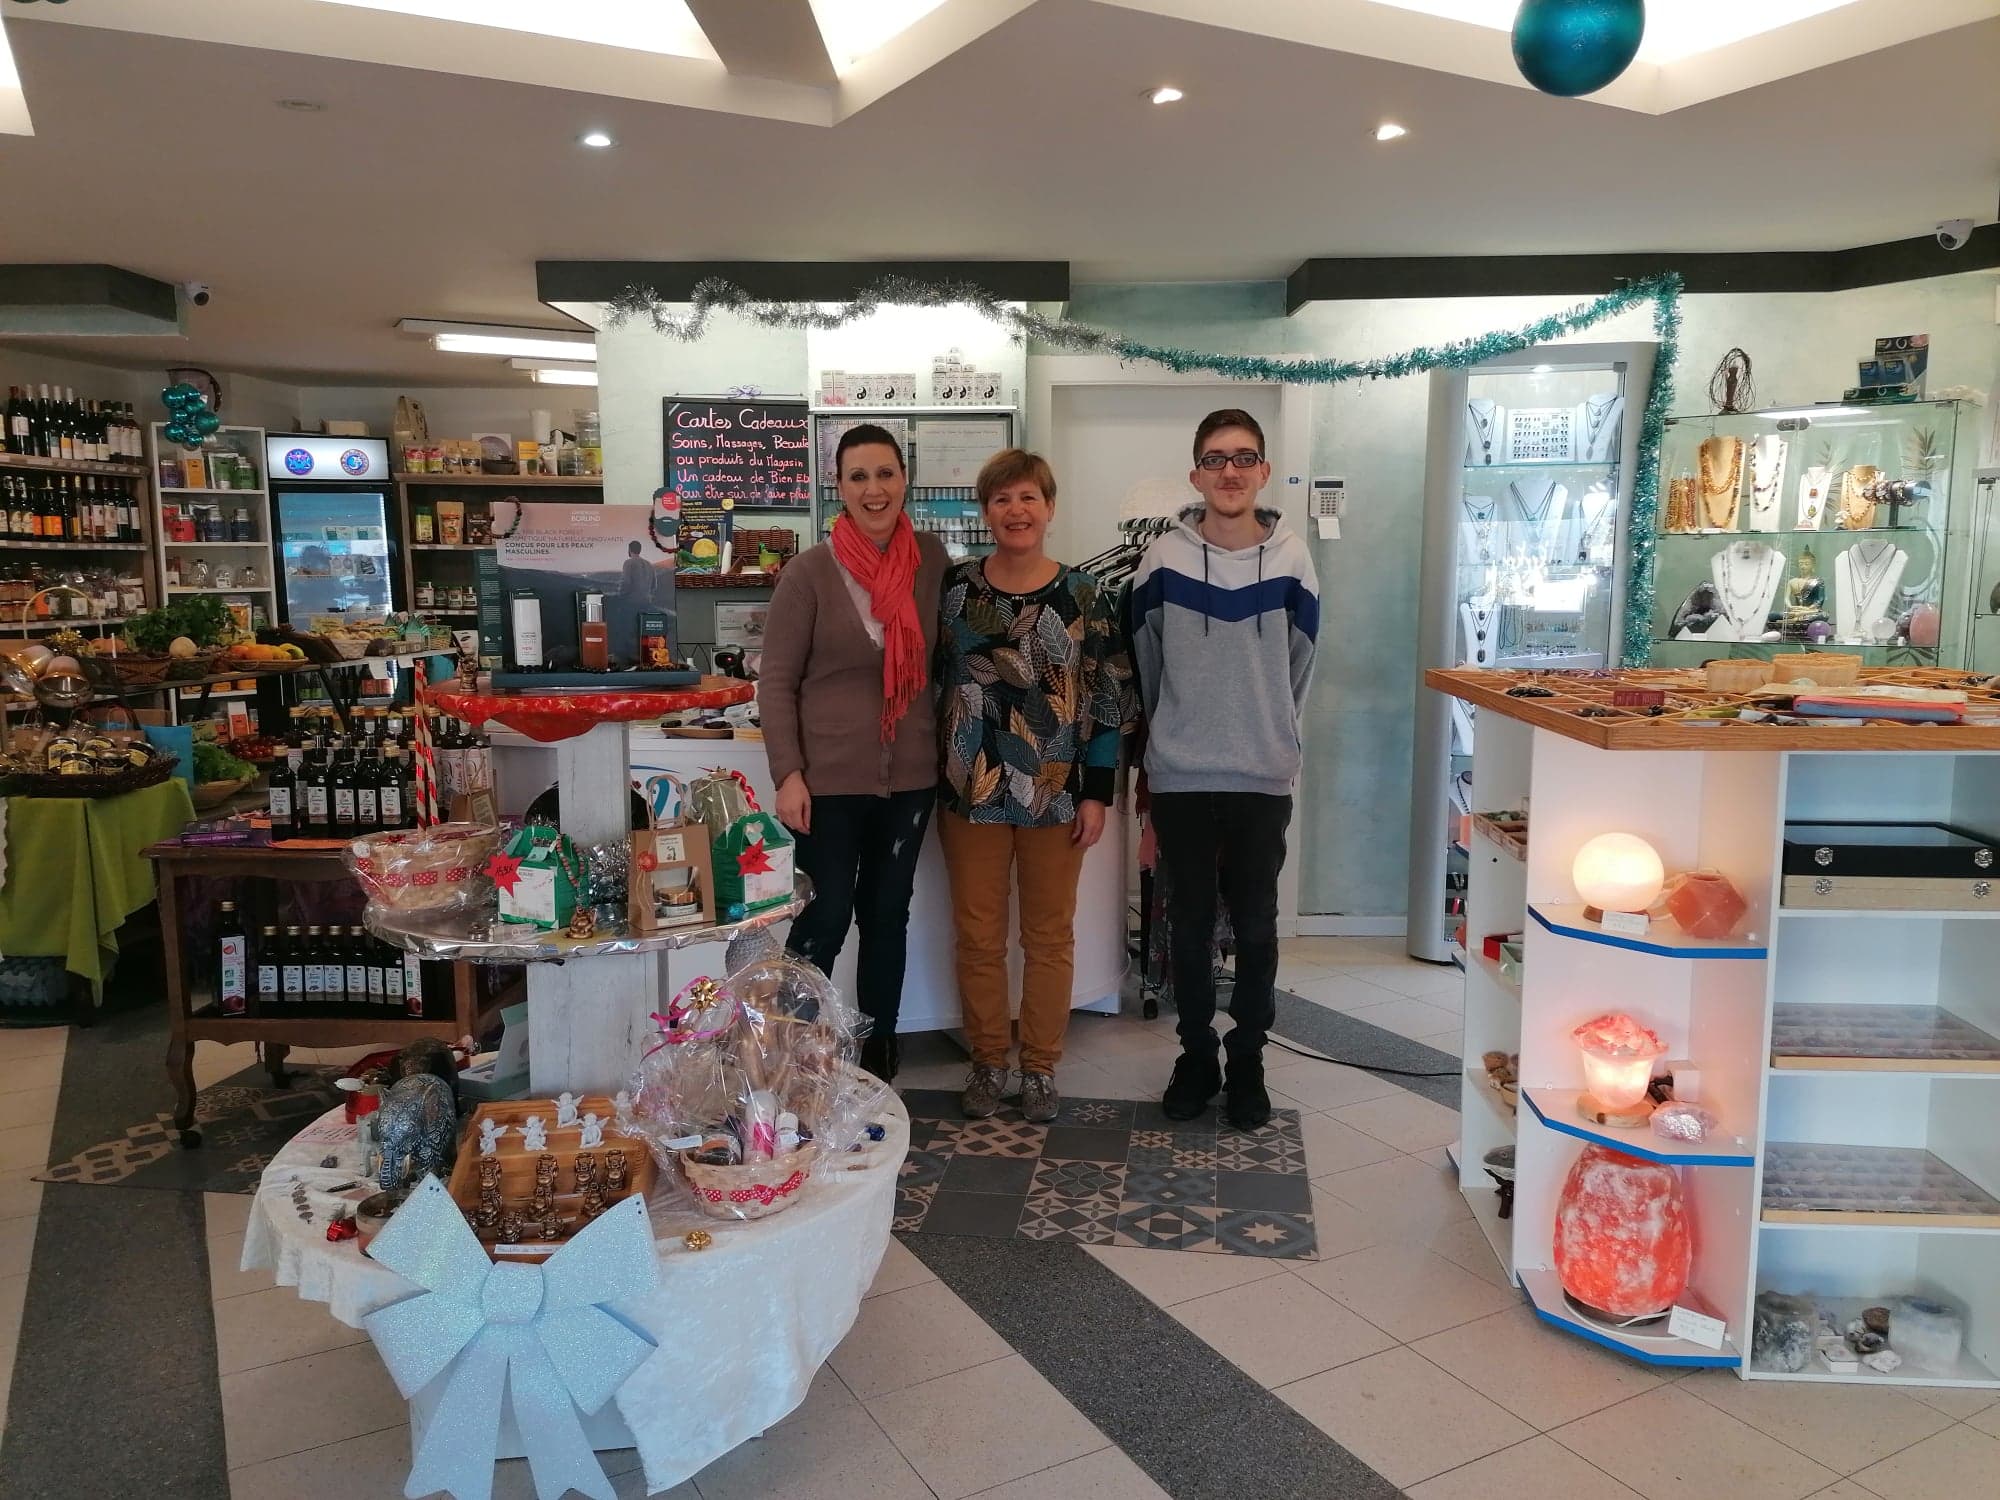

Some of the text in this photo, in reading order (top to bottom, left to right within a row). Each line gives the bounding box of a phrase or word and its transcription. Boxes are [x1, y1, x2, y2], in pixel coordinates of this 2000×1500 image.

[677, 407, 809, 430] Cartes Cadeaux
[672, 433, 713, 450] Soins,
[676, 452, 804, 472] ou produits du Magasin
[677, 469, 699, 482] Un
[702, 469, 744, 482] cadeau
[750, 470, 765, 484] de
[768, 470, 793, 484] Bien
